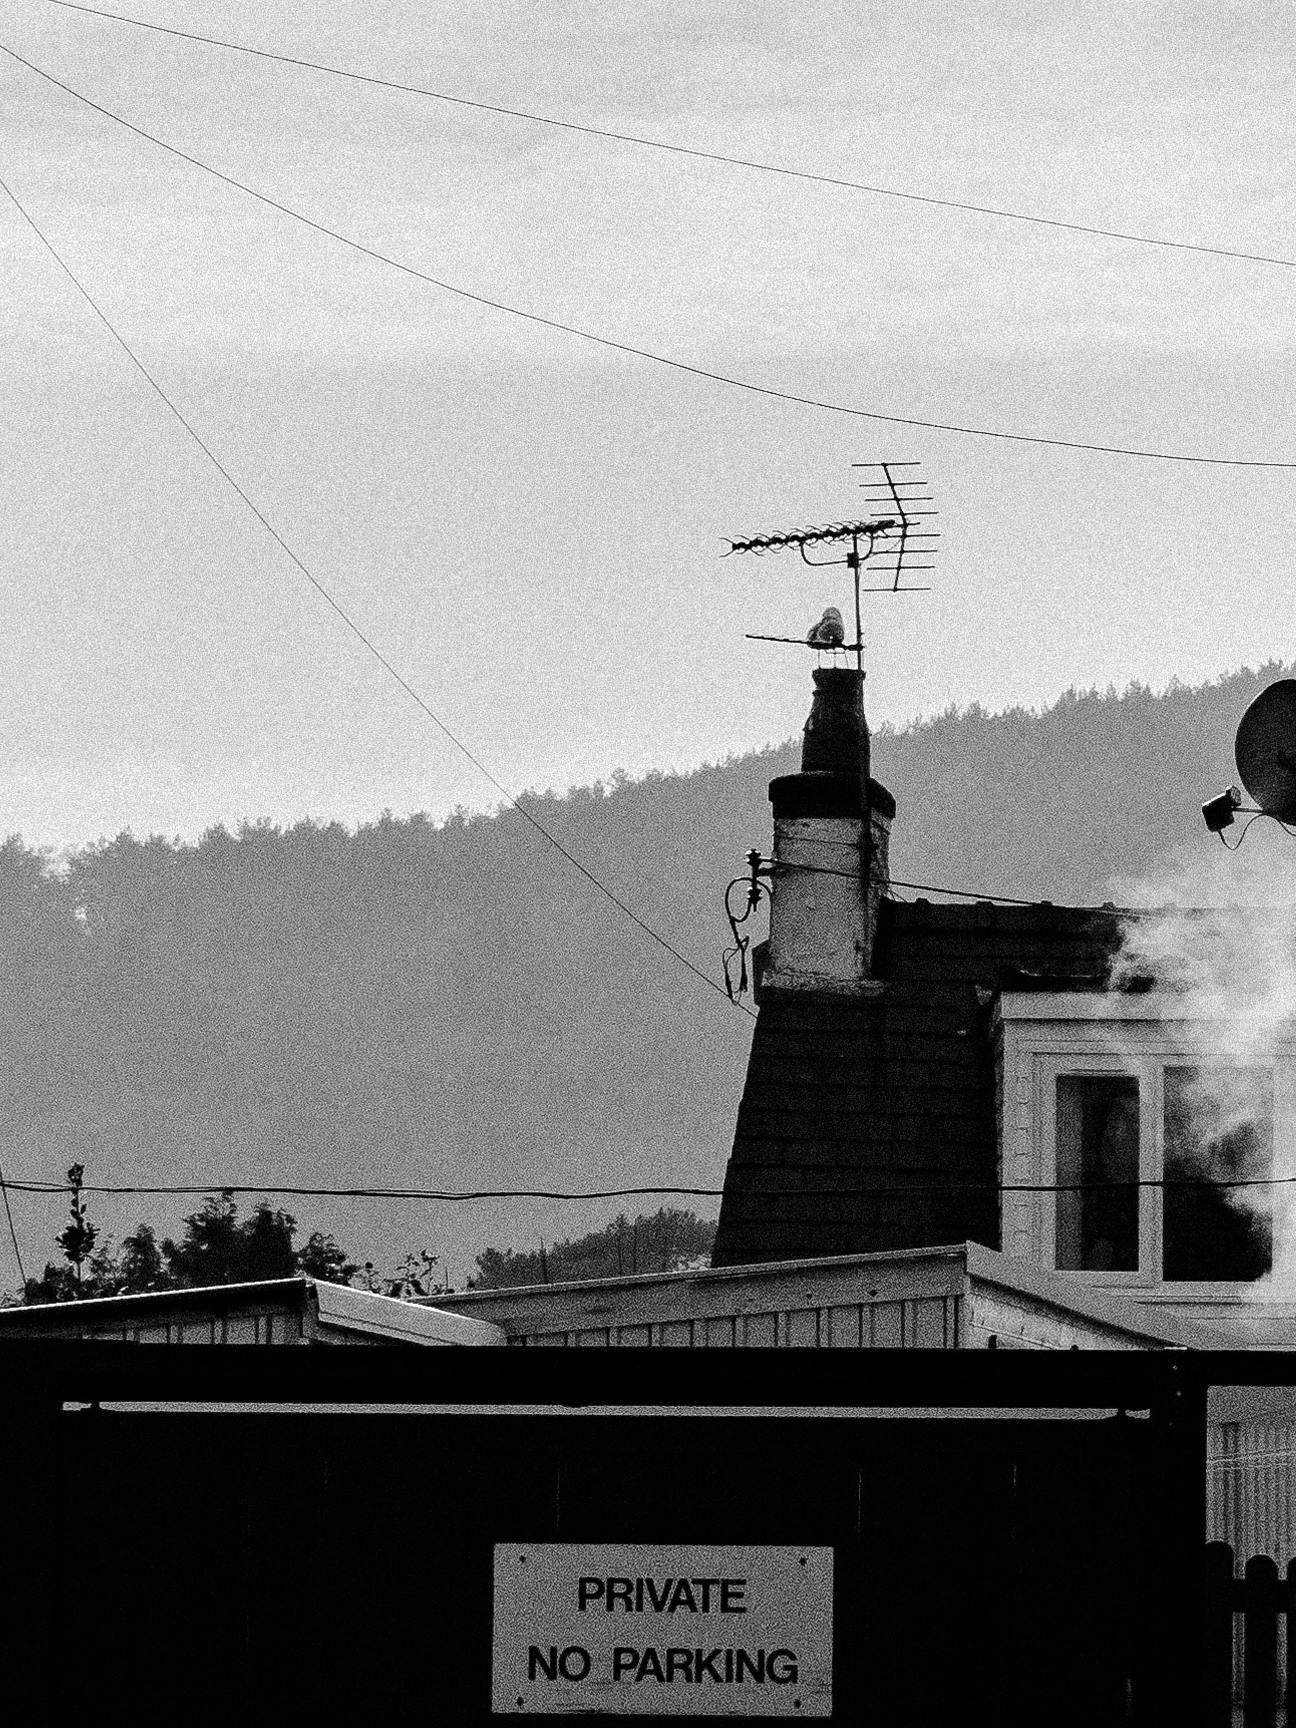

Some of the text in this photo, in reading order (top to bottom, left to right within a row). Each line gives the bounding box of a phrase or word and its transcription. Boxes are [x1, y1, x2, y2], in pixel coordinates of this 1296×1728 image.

[578, 1576, 747, 1613] PRIVATE
[528, 1645, 799, 1684] NO PARKING
